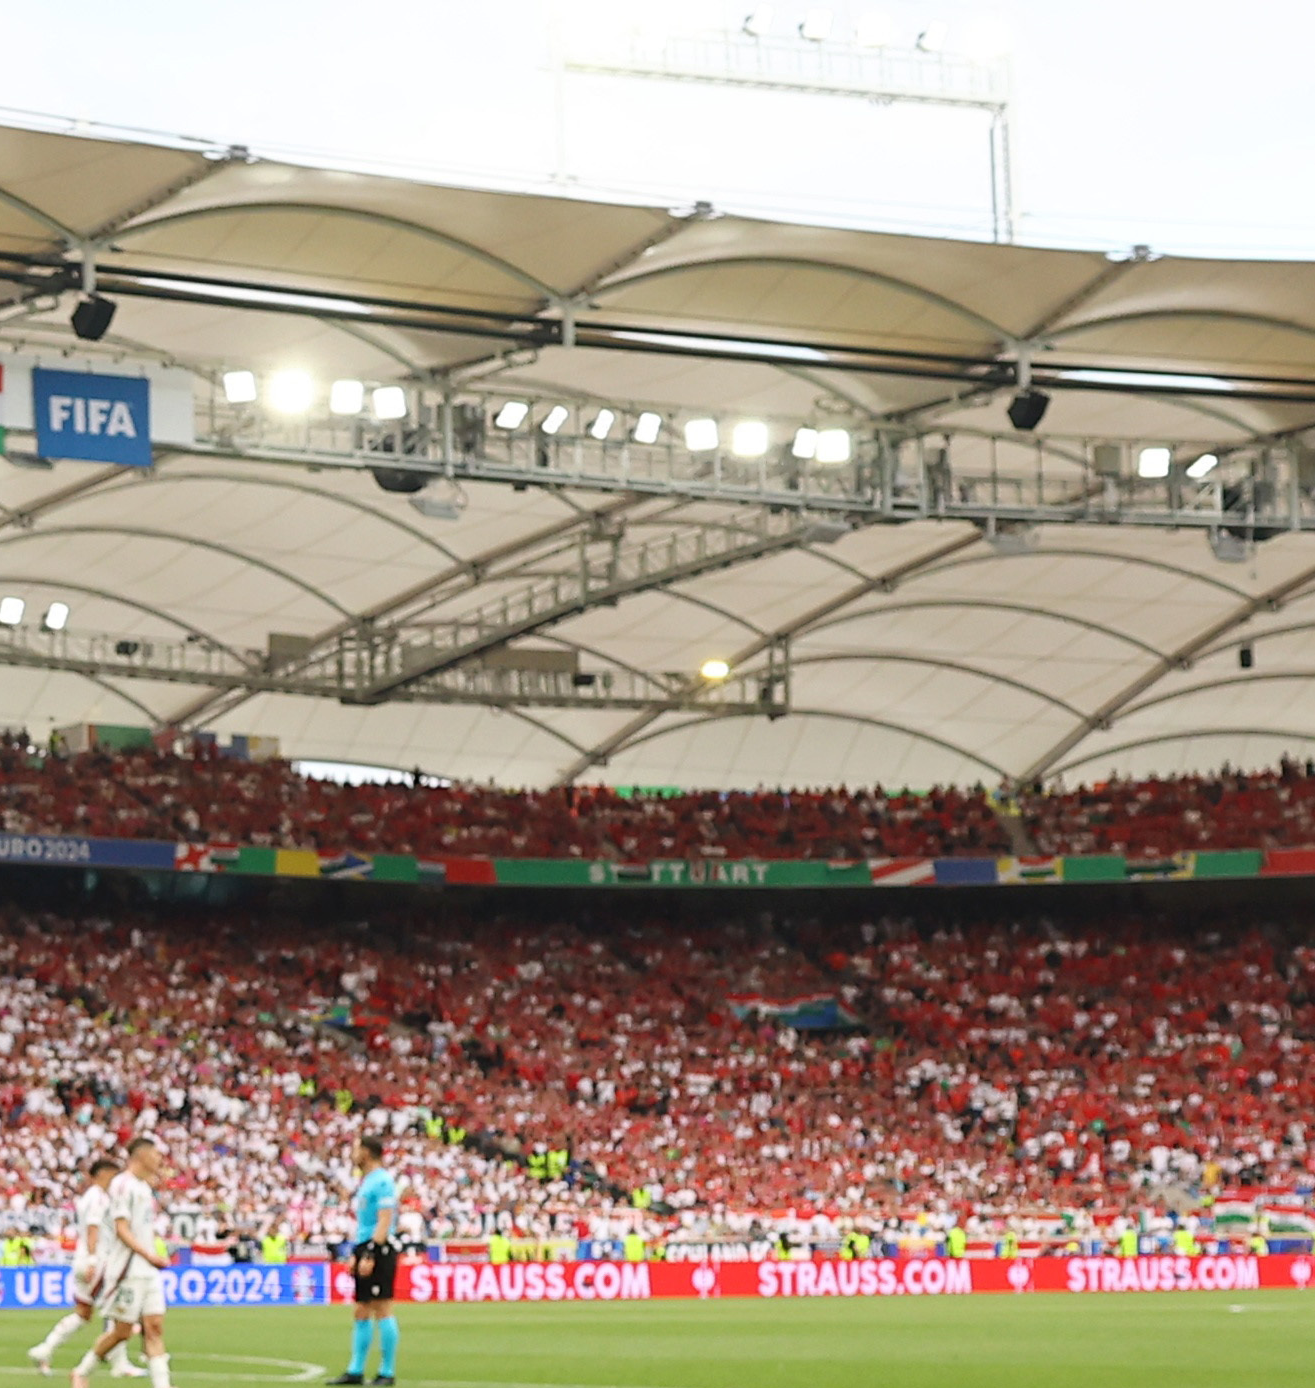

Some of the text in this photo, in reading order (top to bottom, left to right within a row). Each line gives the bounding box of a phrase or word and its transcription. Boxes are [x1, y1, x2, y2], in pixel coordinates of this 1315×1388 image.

[50, 395, 137, 438] FIFA
[410, 1263, 651, 1300] STRAUSS.COM
[758, 1259, 972, 1297] STRAUSS.COM
[1067, 1257, 1259, 1292] STRAUSS.COM
